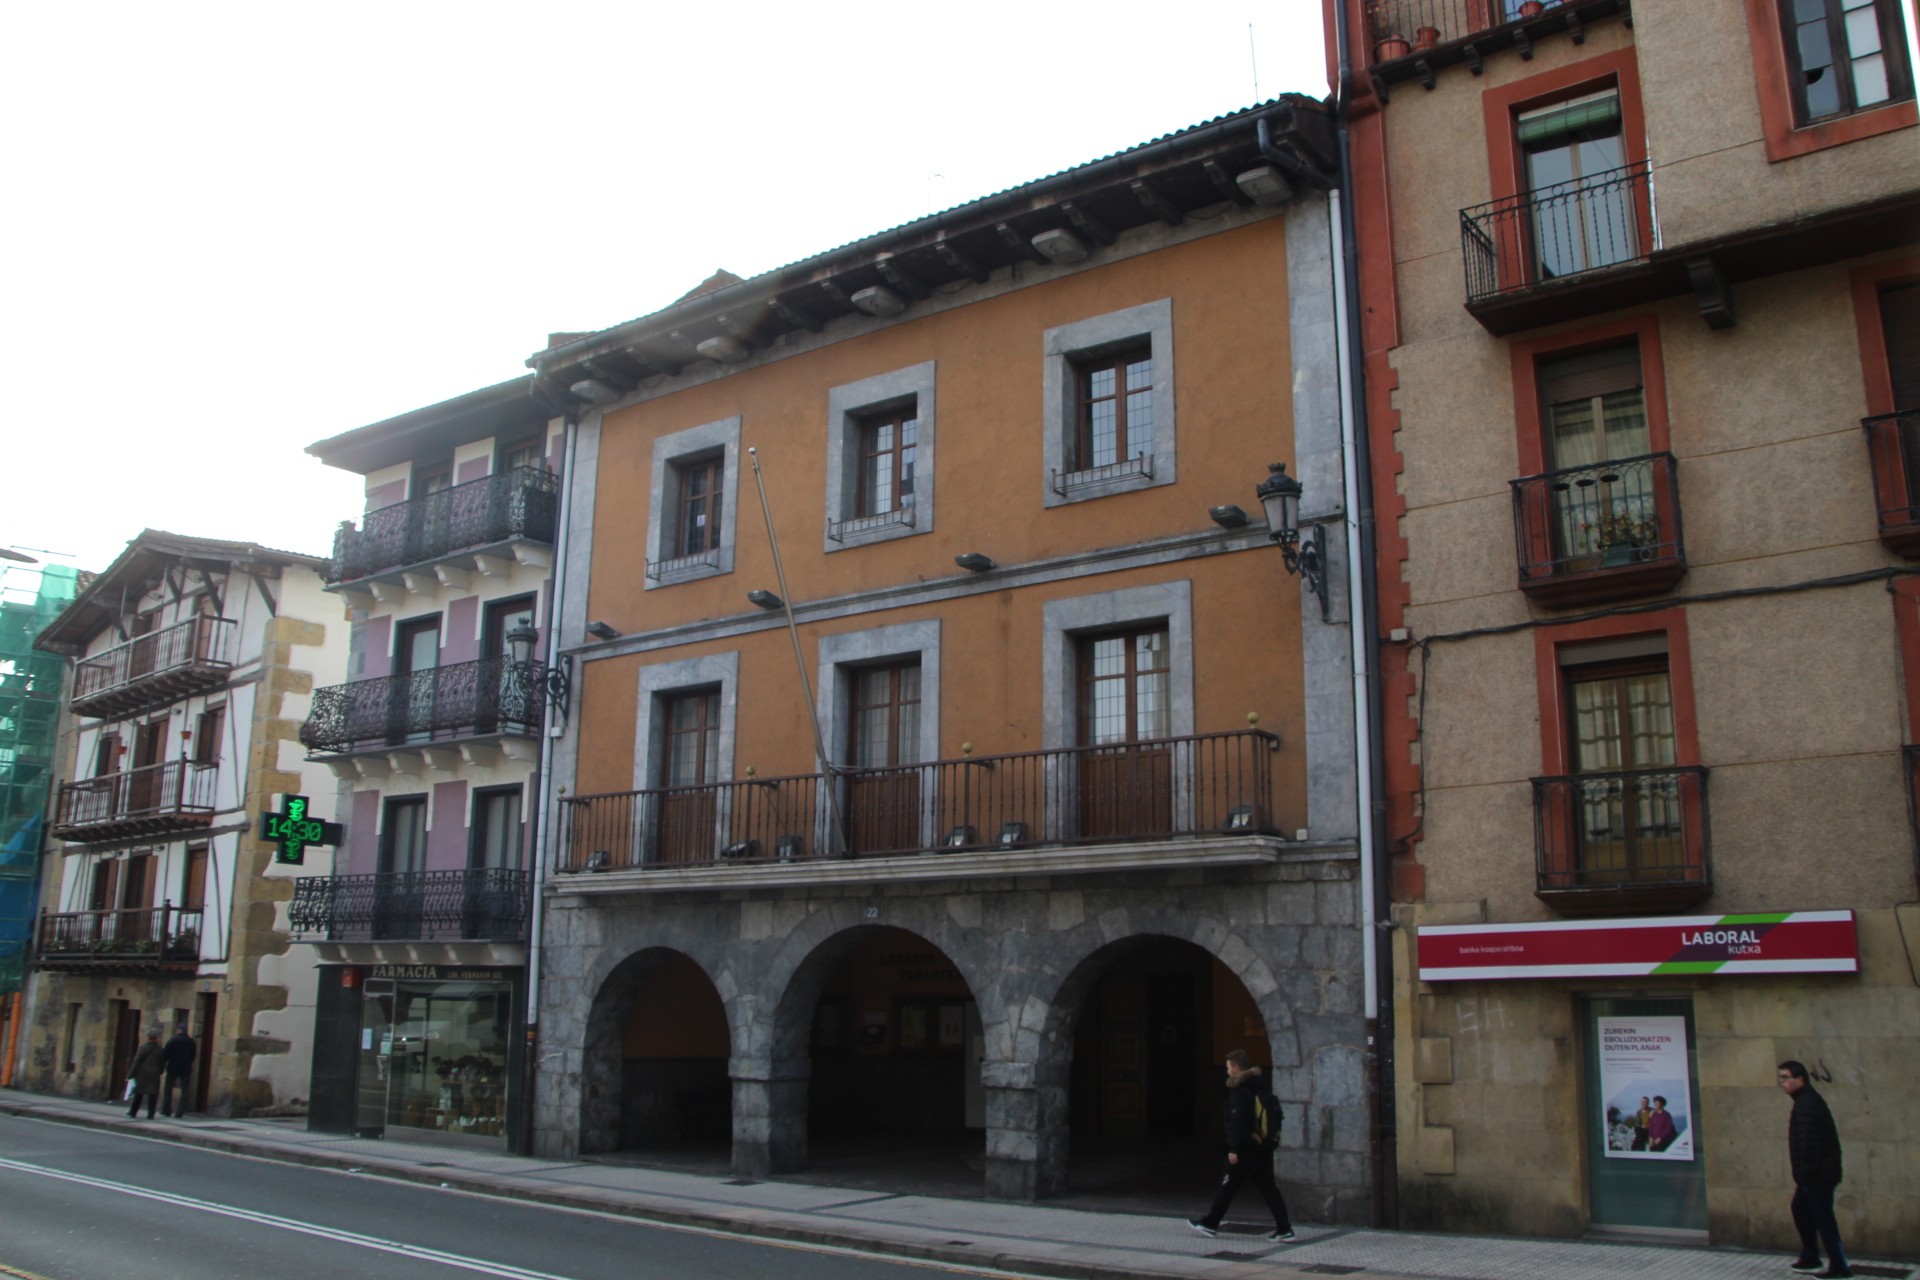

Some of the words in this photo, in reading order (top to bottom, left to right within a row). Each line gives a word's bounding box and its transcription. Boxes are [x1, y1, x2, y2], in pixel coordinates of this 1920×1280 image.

[867, 906, 878, 918] 22
[1681, 930, 1760, 947] LABORAL
[1459, 946, 1479, 954] banka
[1480, 945, 1524, 954] kooperatiboa
[1728, 943, 1762, 955] kutxa
[372, 965, 437, 979] FARMACIA
